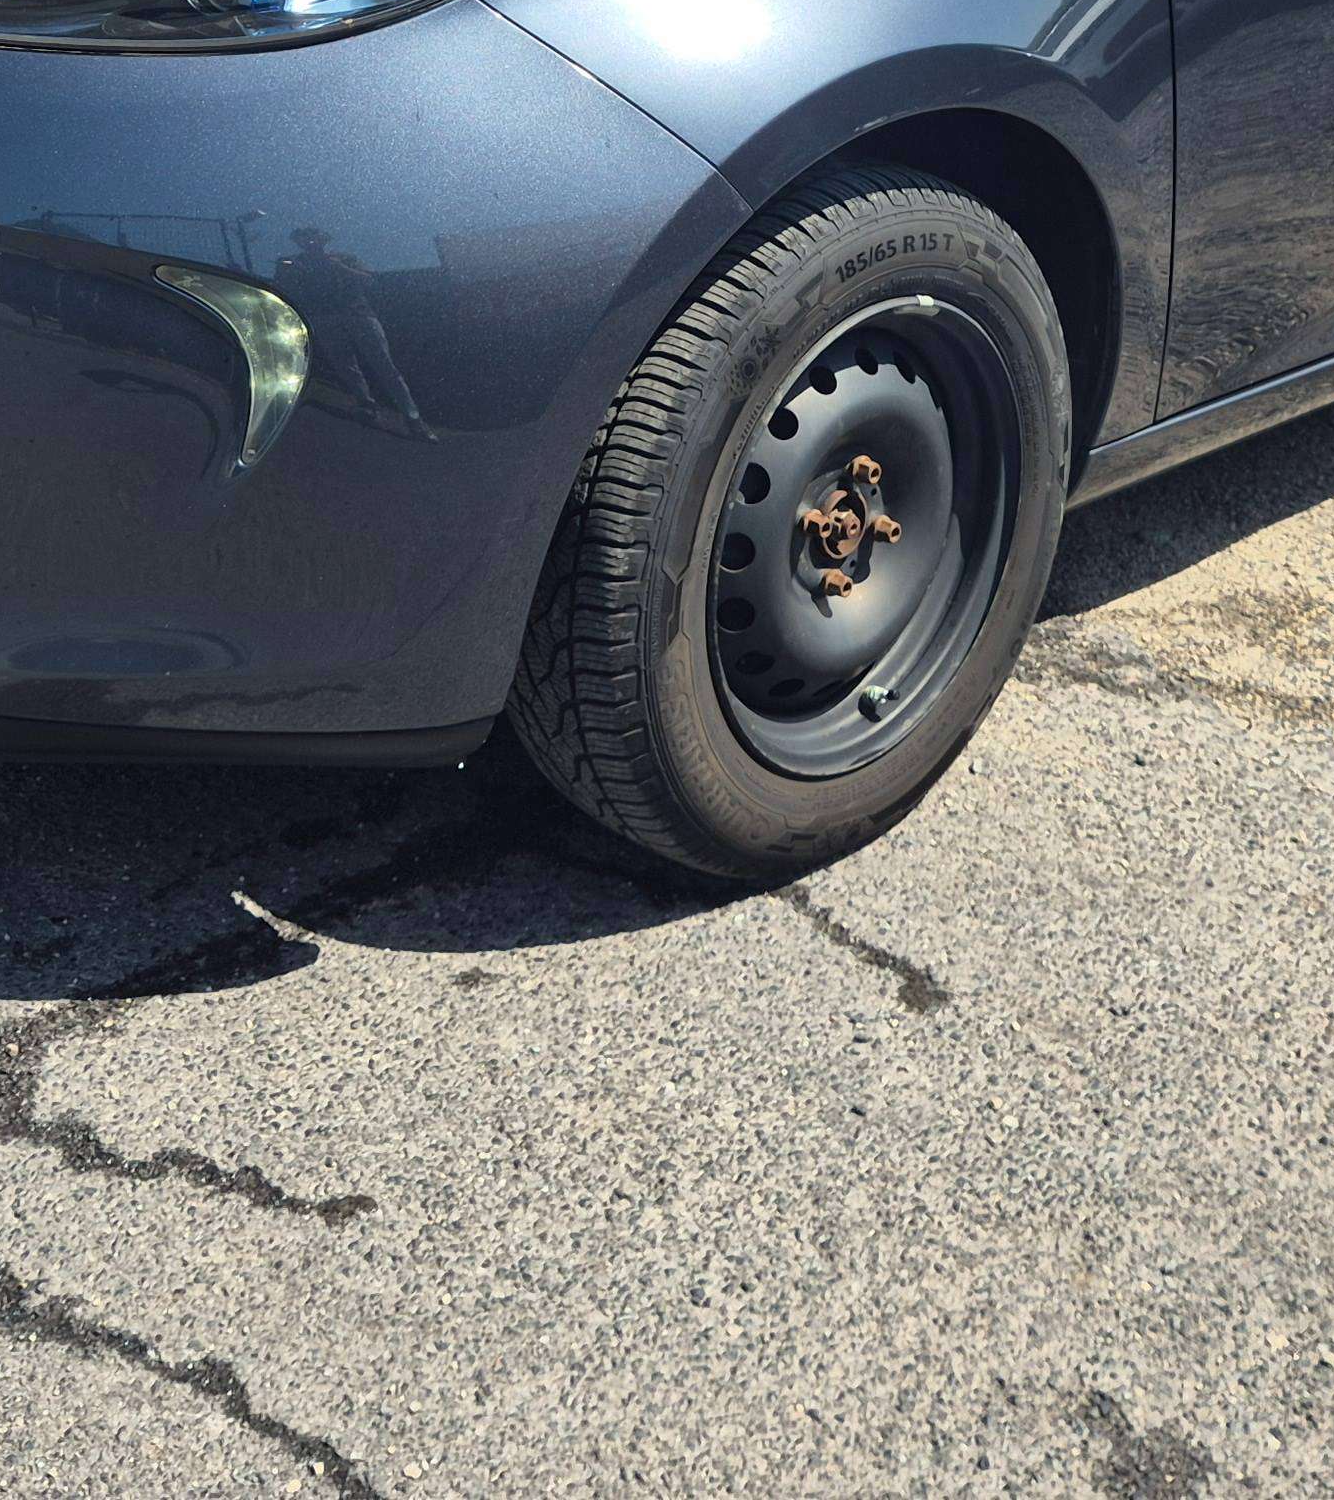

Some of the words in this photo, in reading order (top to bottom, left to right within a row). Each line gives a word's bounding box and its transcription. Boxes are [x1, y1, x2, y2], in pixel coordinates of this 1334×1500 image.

[835, 238, 898, 283] 185/65
[902, 234, 916, 254] R
[919, 232, 938, 251] 15
[942, 233, 955, 252] T
